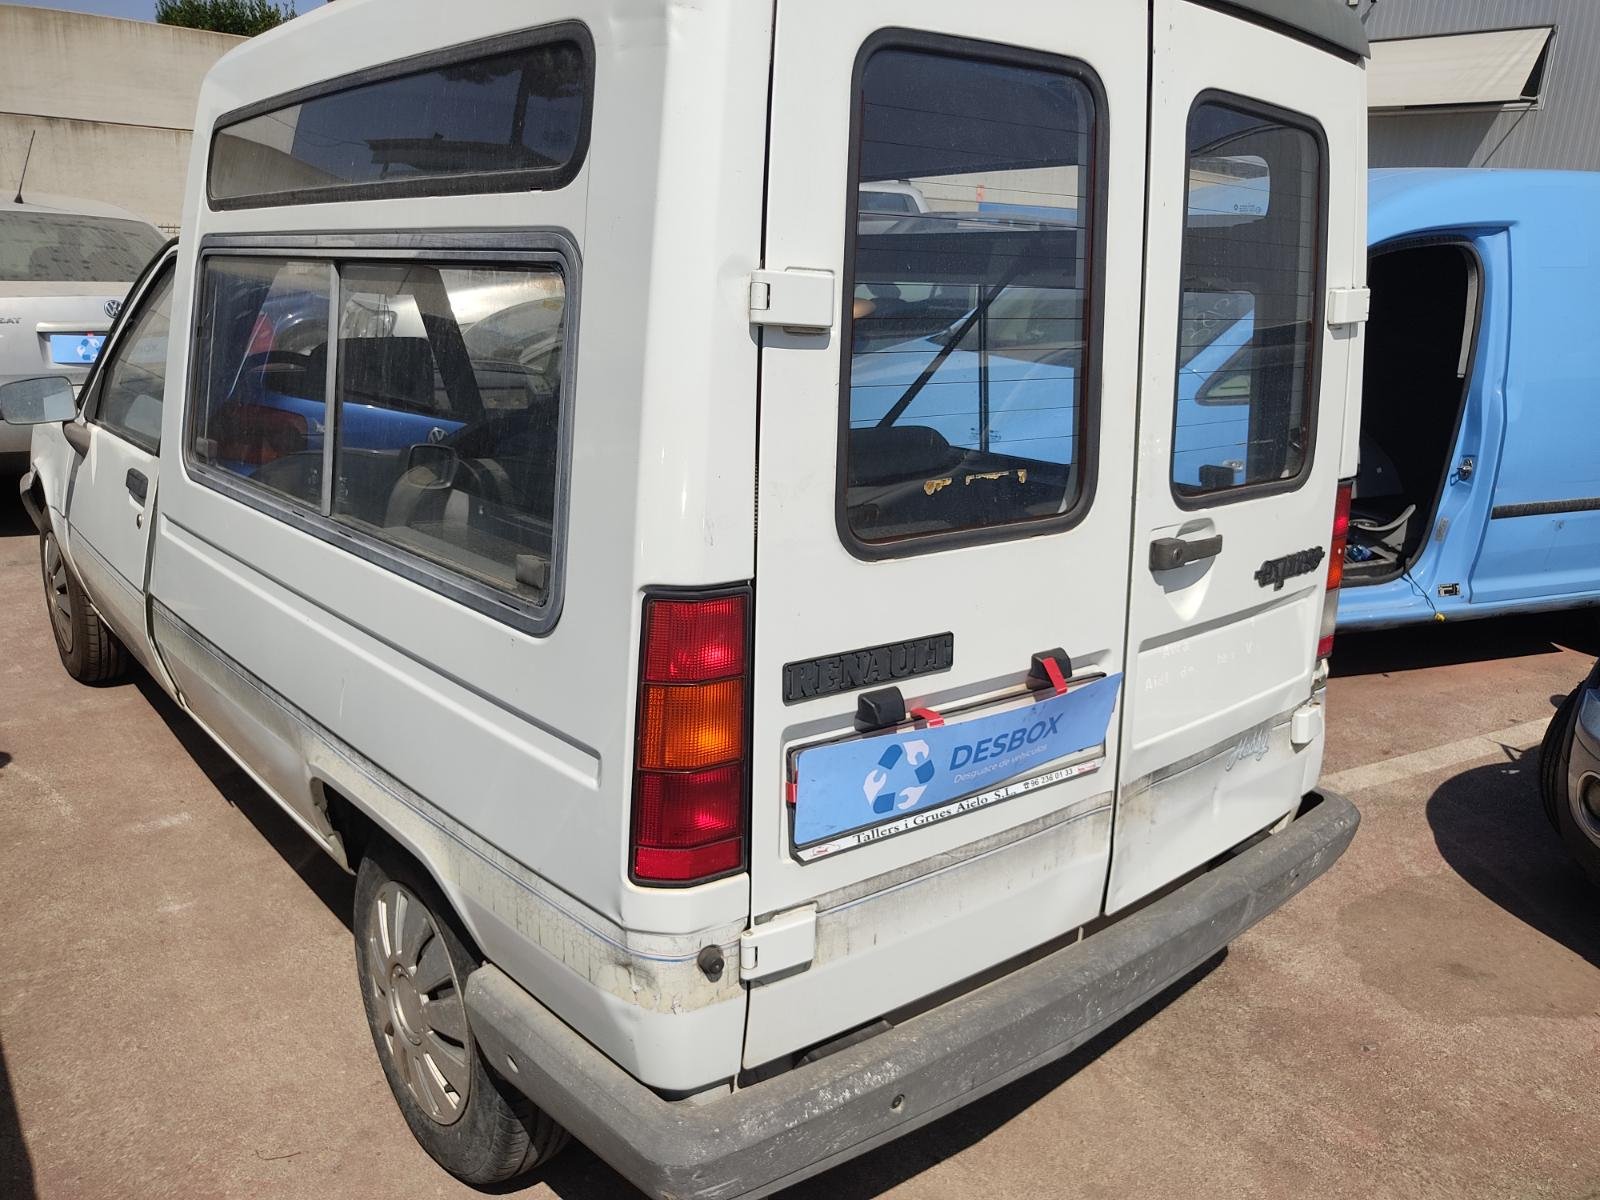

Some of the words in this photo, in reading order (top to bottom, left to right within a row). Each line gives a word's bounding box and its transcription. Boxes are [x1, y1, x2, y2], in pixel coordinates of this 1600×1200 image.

[787, 638, 951, 701] RENAULT
[949, 712, 1064, 771] DESBOX
[852, 824, 900, 844] Tallers
[913, 808, 952, 825] Grues
[956, 795, 988, 813] Aielo
[994, 787, 1017, 800] S.L.
[1030, 779, 1040, 788] 96
